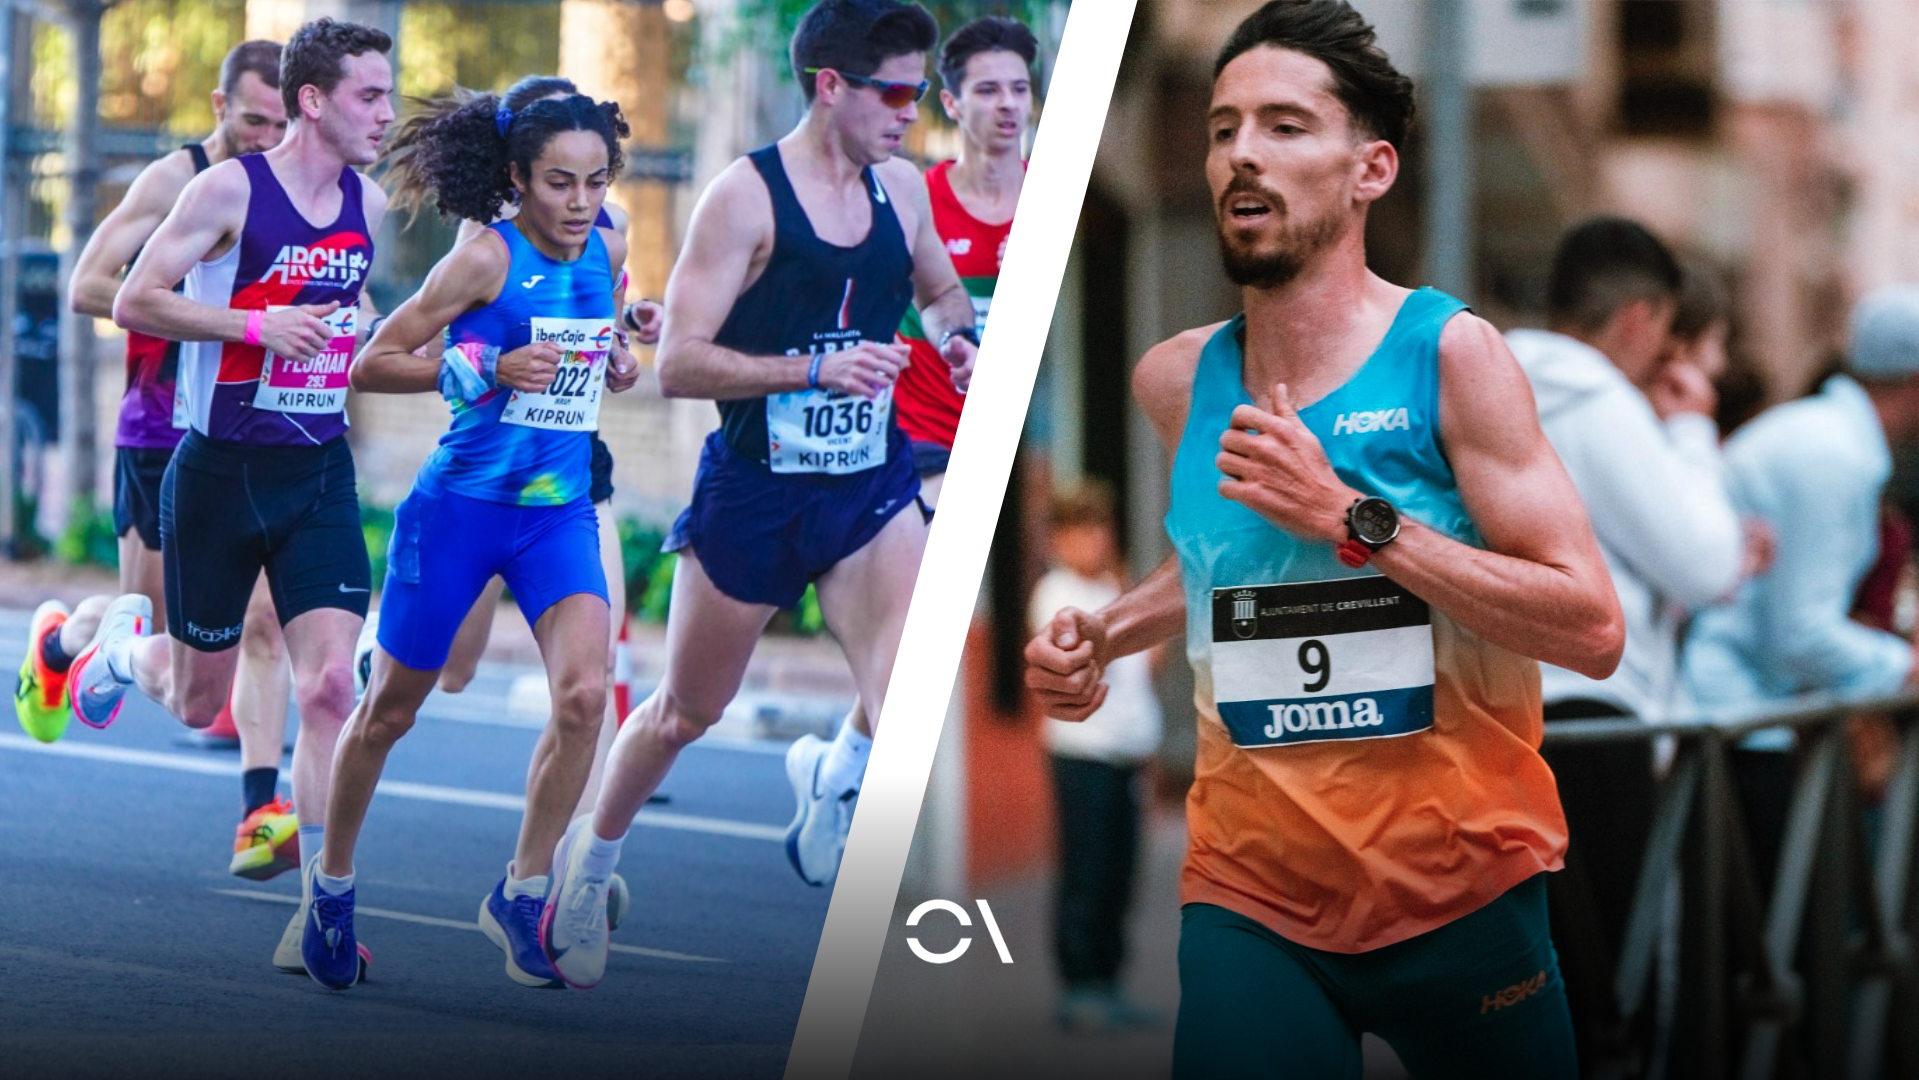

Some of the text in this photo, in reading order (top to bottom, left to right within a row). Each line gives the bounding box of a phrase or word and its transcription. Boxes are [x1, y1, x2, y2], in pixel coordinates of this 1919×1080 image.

[258, 245, 347, 285] ARCH
[535, 328, 586, 346] iberCaja
[304, 374, 328, 389] 293
[541, 366, 591, 397] 022
[277, 391, 336, 407] KIPRUN
[525, 407, 585, 425] KIPRUN
[802, 400, 873, 438] 1036
[1332, 407, 1410, 436] HOKA
[799, 445, 870, 468] KIPRUN
[1260, 595, 1401, 617] AJUNTAMENT DE CREVILLENT
[1297, 639, 1331, 693] 9
[1481, 970, 1546, 1015] HOKA
